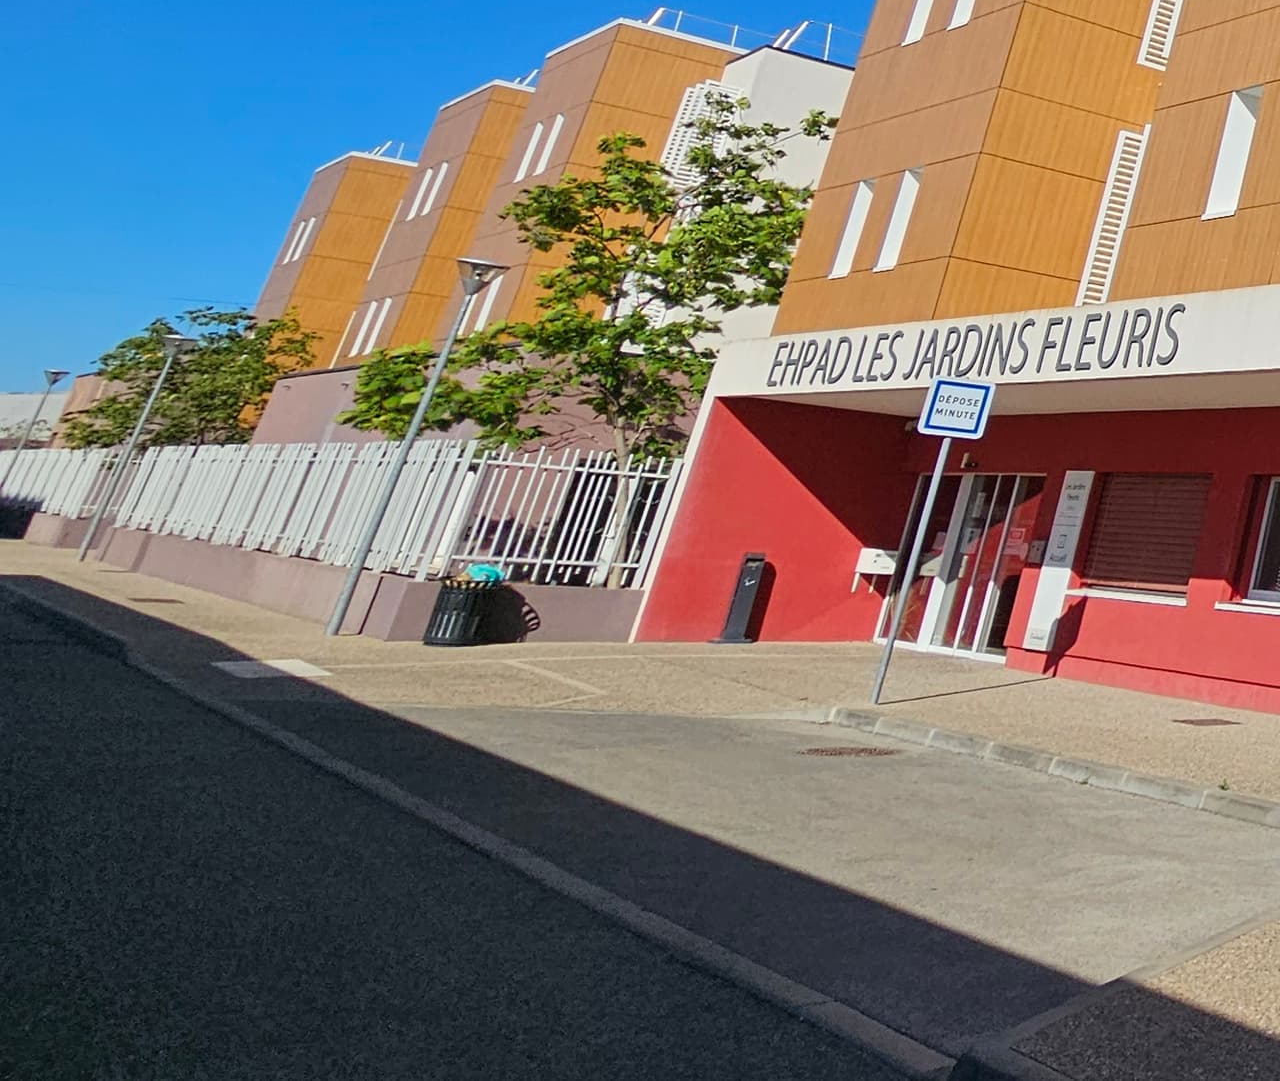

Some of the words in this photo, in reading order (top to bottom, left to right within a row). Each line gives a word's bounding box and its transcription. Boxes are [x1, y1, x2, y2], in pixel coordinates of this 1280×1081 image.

[766, 336, 852, 387] EHPAD
[852, 330, 905, 382] LES
[903, 318, 1036, 380] JARDINS
[1036, 303, 1186, 373] FLEURIS
[938, 395, 981, 407] DÉPOSE
[935, 408, 976, 420] MINUTE
